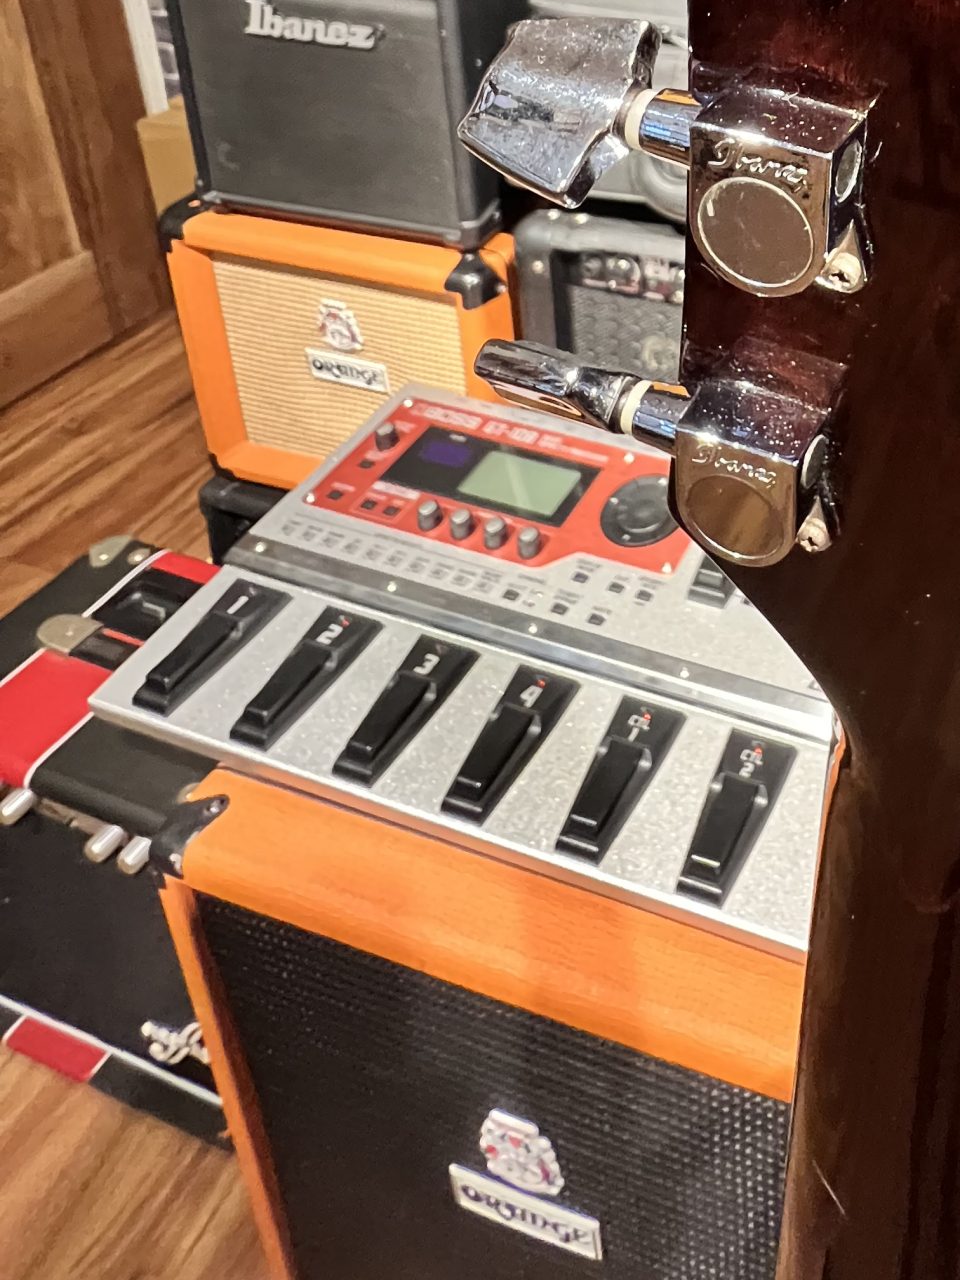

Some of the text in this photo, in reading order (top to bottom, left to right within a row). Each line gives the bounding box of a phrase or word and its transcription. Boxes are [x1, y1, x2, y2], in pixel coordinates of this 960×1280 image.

[708, 138, 808, 193] Ibanez
[226, 594, 249, 615] 1
[315, 623, 343, 645] 2
[413, 653, 440, 675] 3
[519, 684, 544, 708] 4
